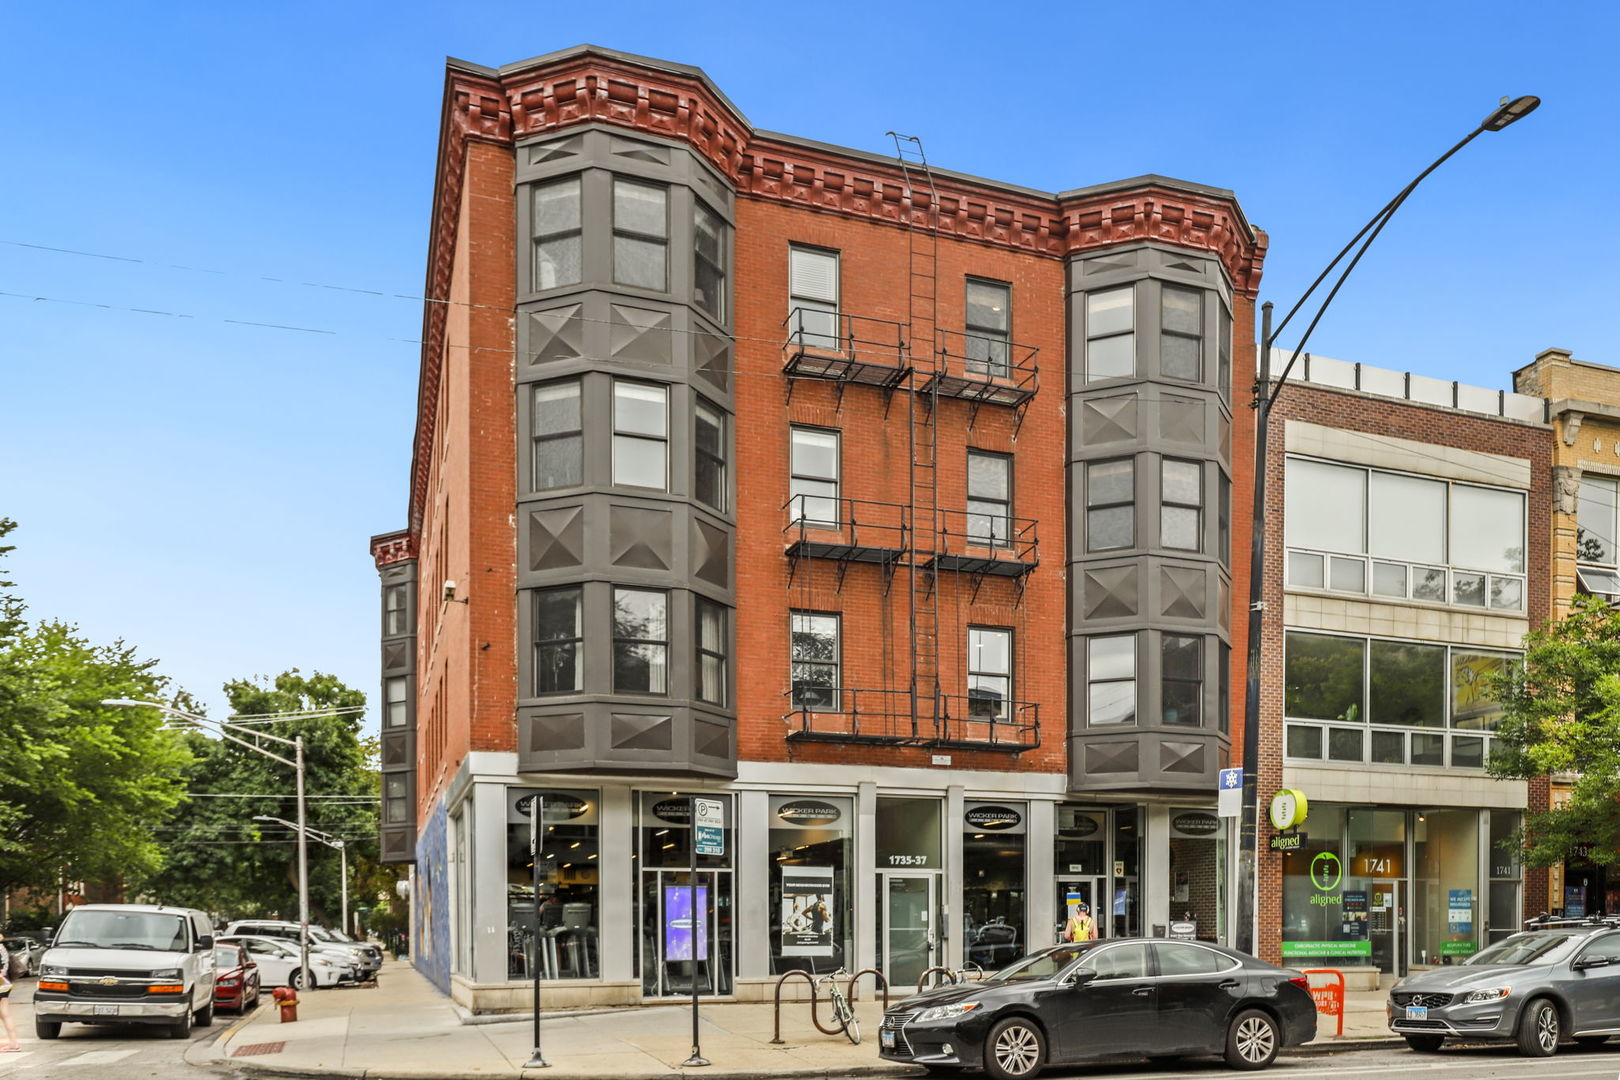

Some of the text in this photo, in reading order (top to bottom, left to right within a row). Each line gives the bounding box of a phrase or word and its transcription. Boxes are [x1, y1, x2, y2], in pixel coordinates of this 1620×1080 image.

[1271, 834, 1300, 850] aligned
[889, 855, 928, 865] 1735-37
[1364, 858, 1391, 873] 1741
[1496, 866, 1511, 875] 1741
[1310, 894, 1342, 907] aligned
